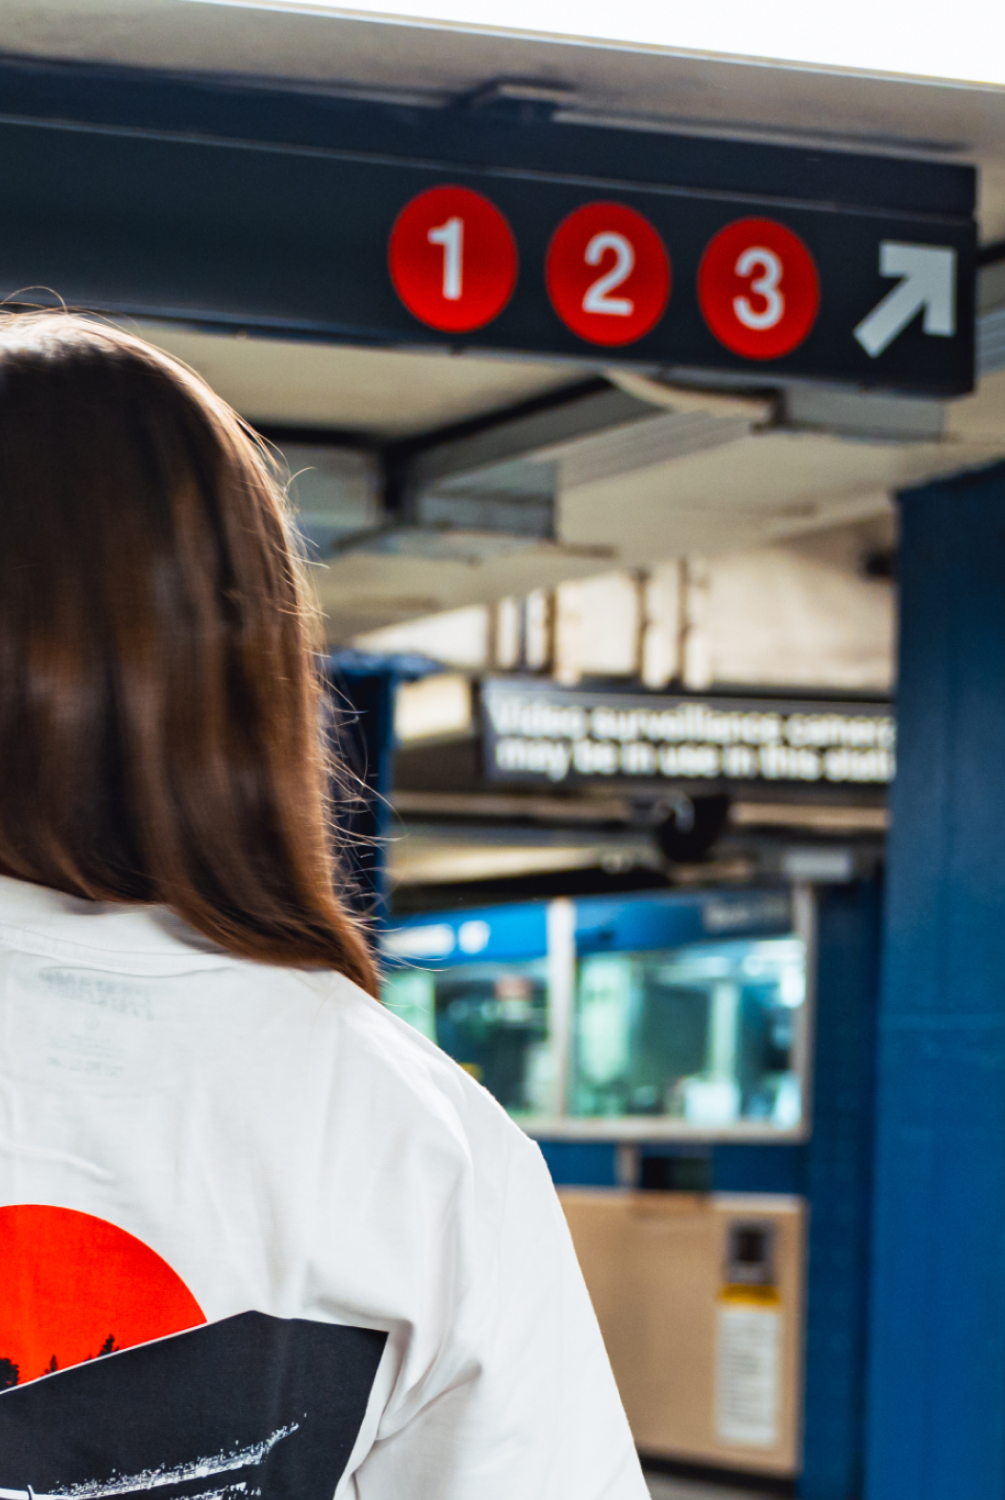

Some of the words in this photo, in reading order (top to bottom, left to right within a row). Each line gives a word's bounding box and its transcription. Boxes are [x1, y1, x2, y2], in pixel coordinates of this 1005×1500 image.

[427, 216, 464, 301] 1
[581, 230, 634, 317] 2
[732, 245, 786, 332] 3
[490, 699, 588, 738] Video
[591, 703, 783, 743] surveillance
[496, 738, 571, 781] may
[573, 738, 618, 775] be
[621, 739, 656, 777] in
[658, 743, 721, 778] use
[723, 743, 758, 779] in
[760, 744, 822, 781] this
